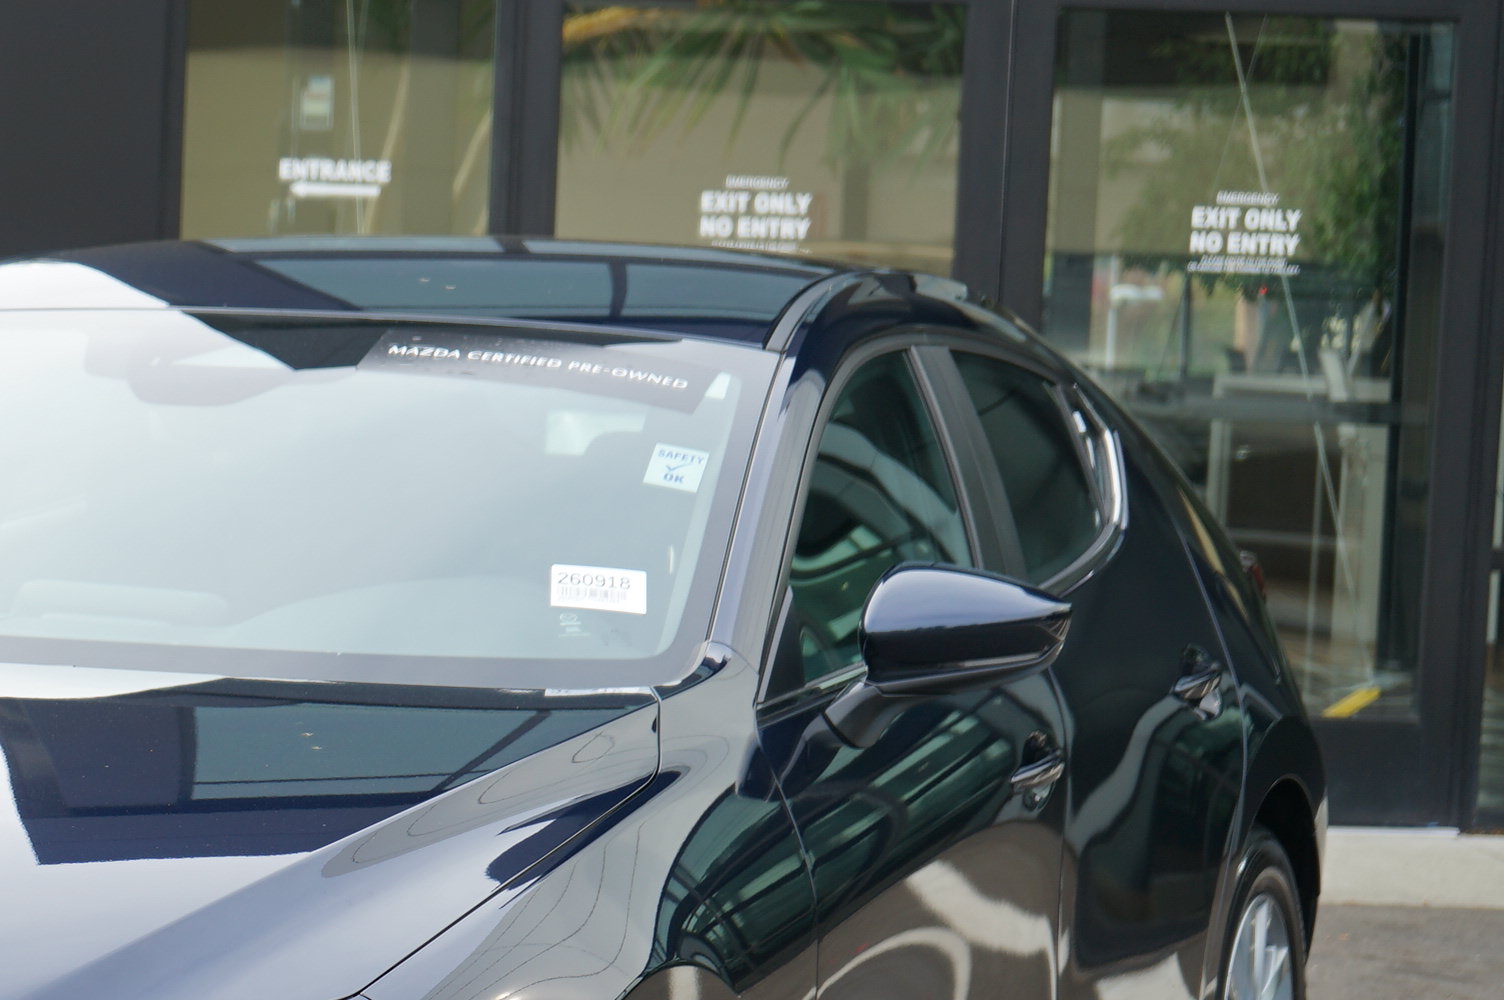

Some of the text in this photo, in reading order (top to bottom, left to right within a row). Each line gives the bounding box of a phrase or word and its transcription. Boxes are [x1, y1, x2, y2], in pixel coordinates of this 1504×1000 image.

[279, 157, 391, 183] ENTRANCE
[701, 190, 813, 215] EXIT ONLY
[700, 215, 812, 240] NO ENTRY
[1191, 206, 1302, 232] EXIT ONLY
[1190, 231, 1301, 256] NO ENTRY
[388, 345, 688, 389] MAZDA CERTIFIED PRE-OWNED
[658, 449, 705, 465] SAFETY
[664, 472, 684, 484] OK
[558, 572, 631, 590] 260918
